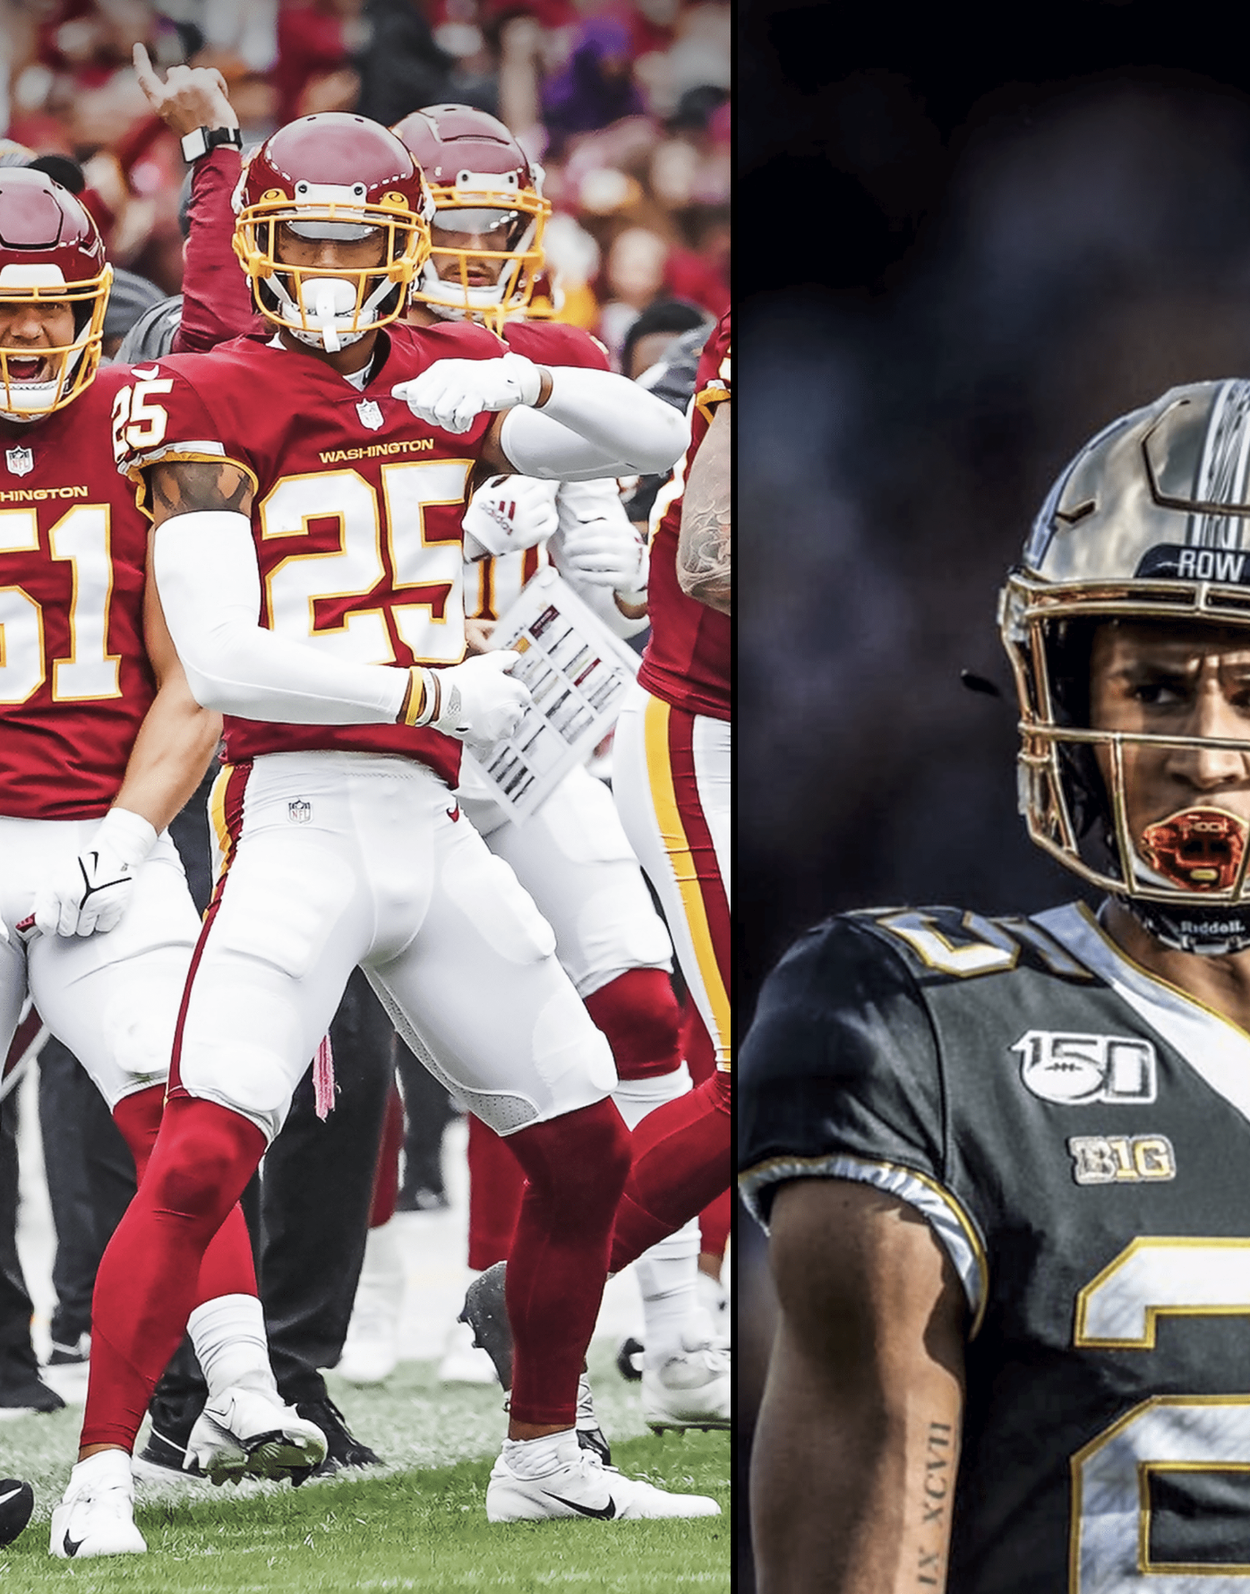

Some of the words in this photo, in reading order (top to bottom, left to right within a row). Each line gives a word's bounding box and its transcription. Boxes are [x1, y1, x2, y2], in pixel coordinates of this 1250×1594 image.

[109, 378, 175, 464] 25
[319, 438, 434, 463] WASHINGTON
[0, 486, 88, 501] HINGTON
[258, 458, 476, 665] 25
[1177, 550, 1245, 582] ROW
